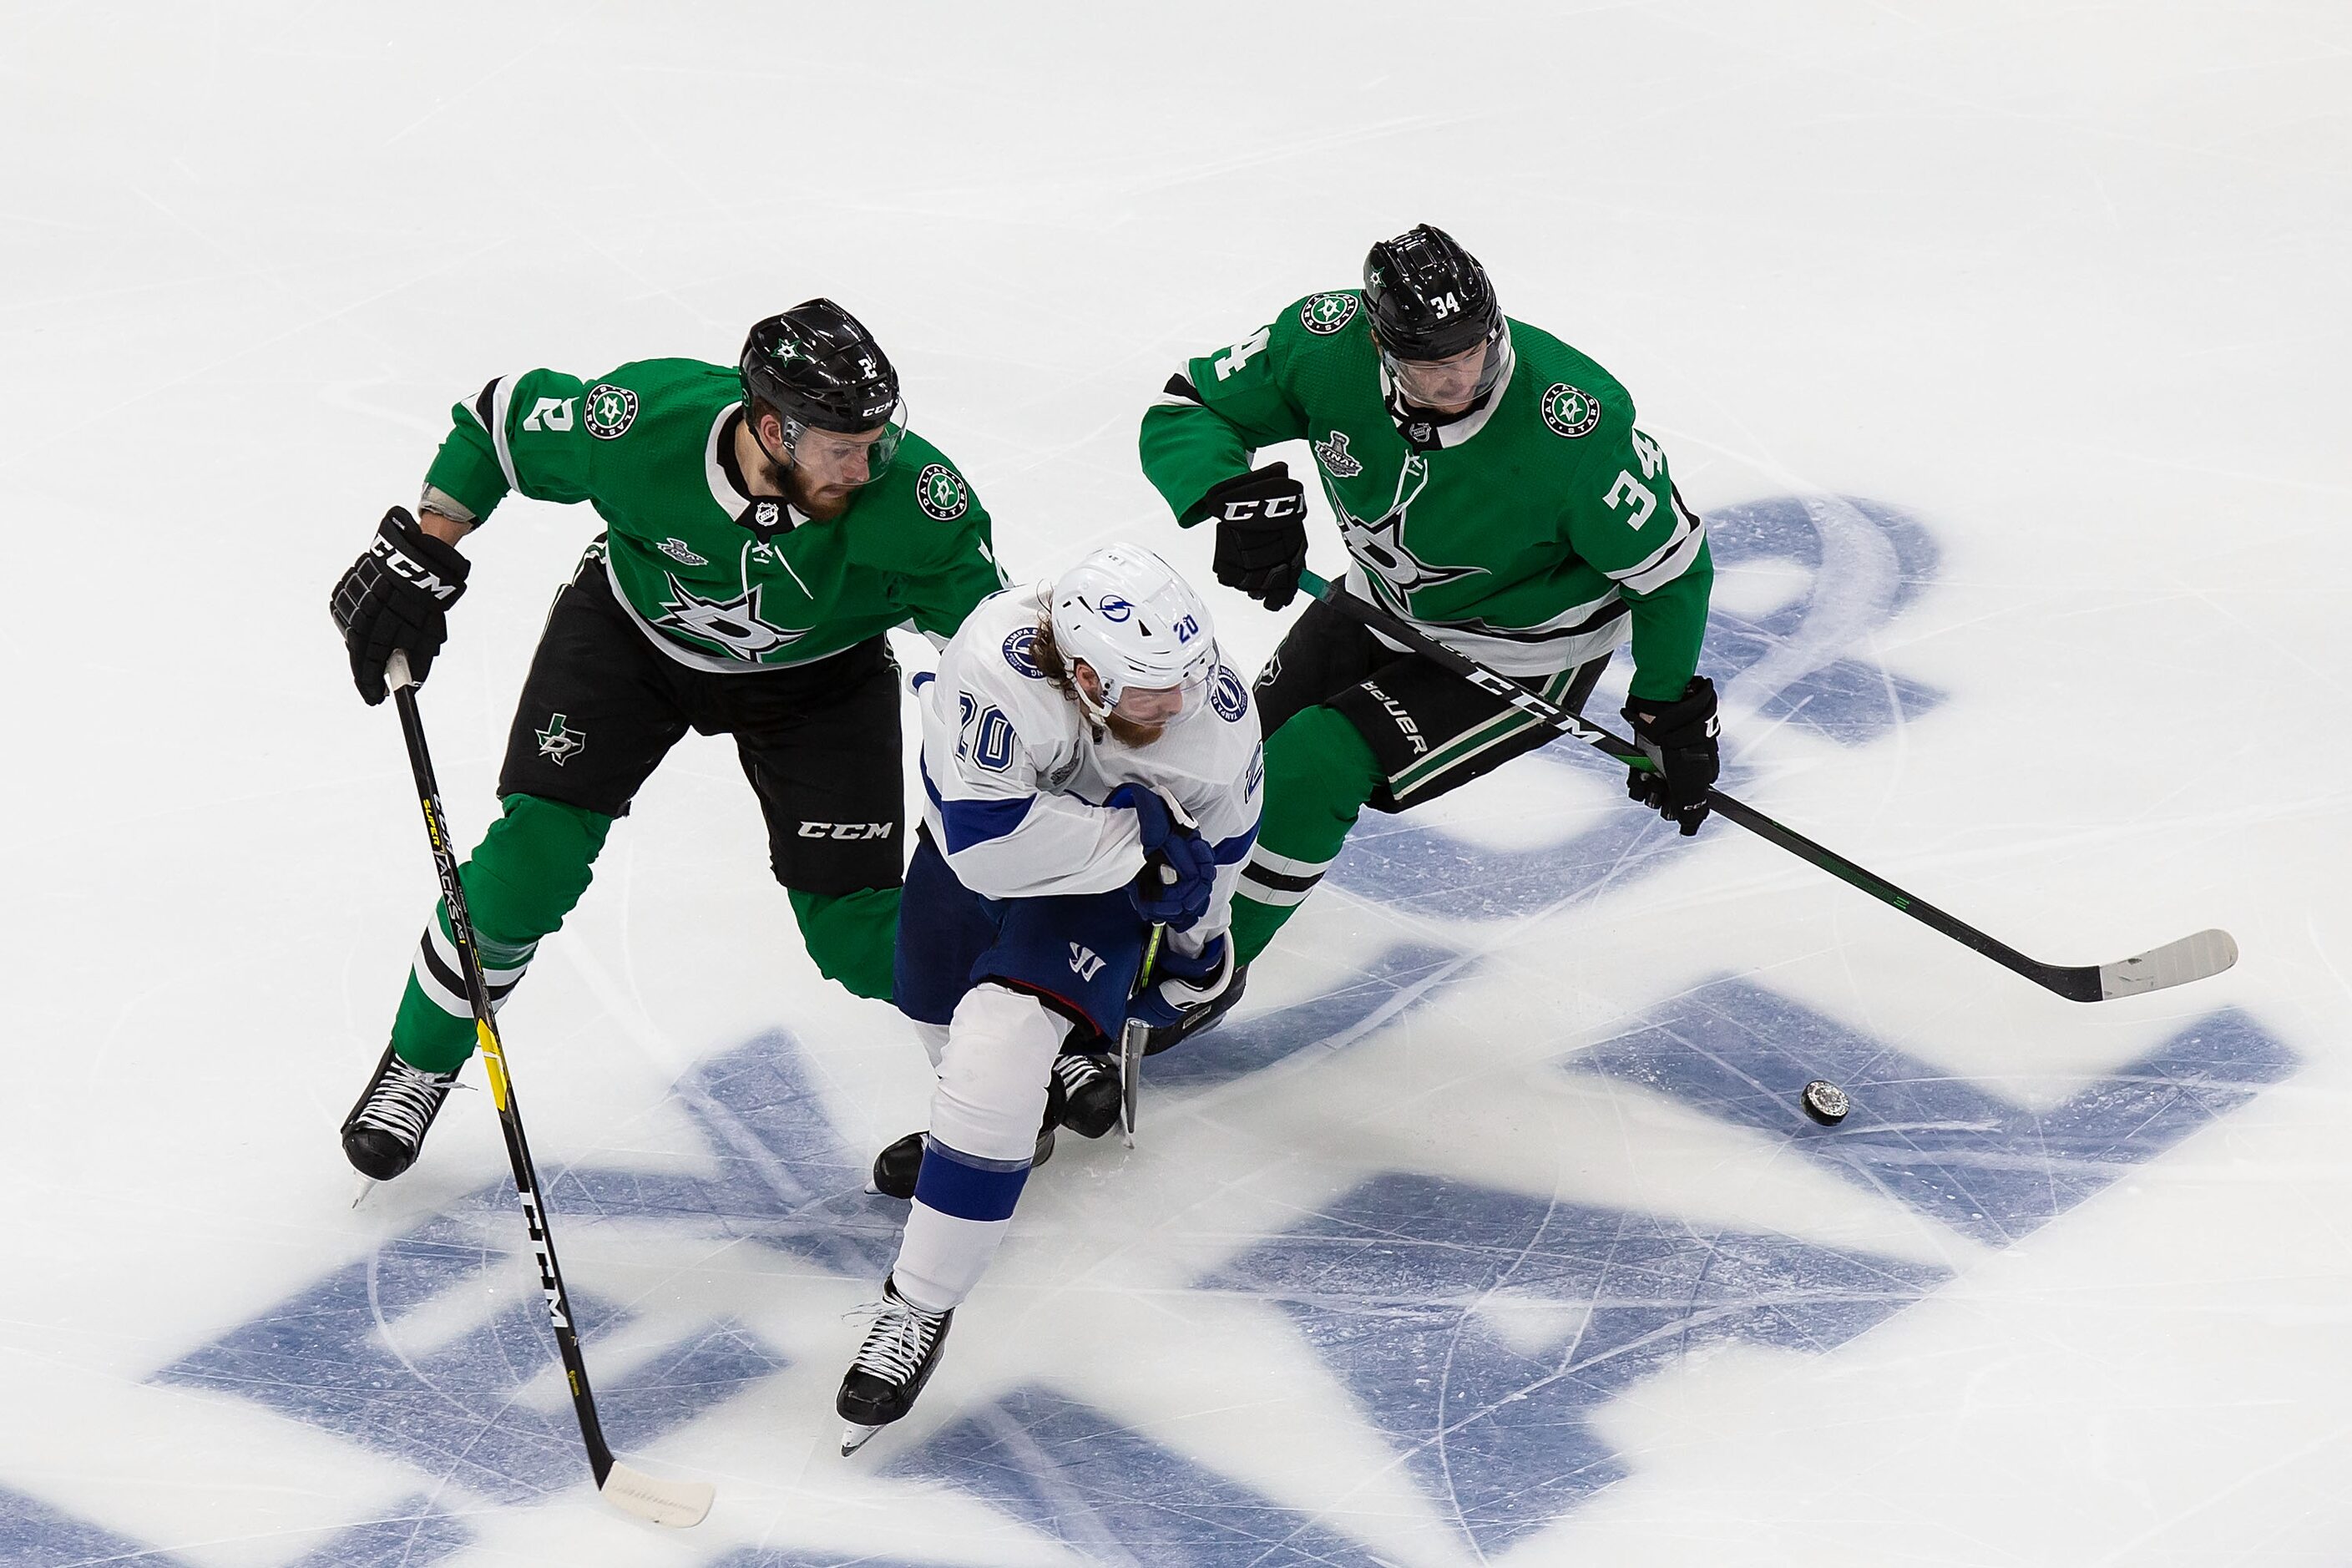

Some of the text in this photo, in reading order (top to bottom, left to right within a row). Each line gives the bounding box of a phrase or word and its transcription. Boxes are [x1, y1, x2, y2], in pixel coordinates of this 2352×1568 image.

[1430, 291, 1460, 319] 34
[858, 358, 878, 379] 2
[523, 396, 579, 431] 2
[862, 398, 893, 417] CCM
[1319, 446, 1359, 468] FINAL
[1602, 427, 1663, 531] 34
[370, 533, 457, 600] CCM
[1004, 628, 1030, 647] TAMPA
[1173, 615, 1199, 644] 20
[1465, 666, 1606, 745] CCM
[423, 799, 441, 847] SUPER
[797, 821, 893, 840] CCM
[432, 850, 462, 920] TACKS
